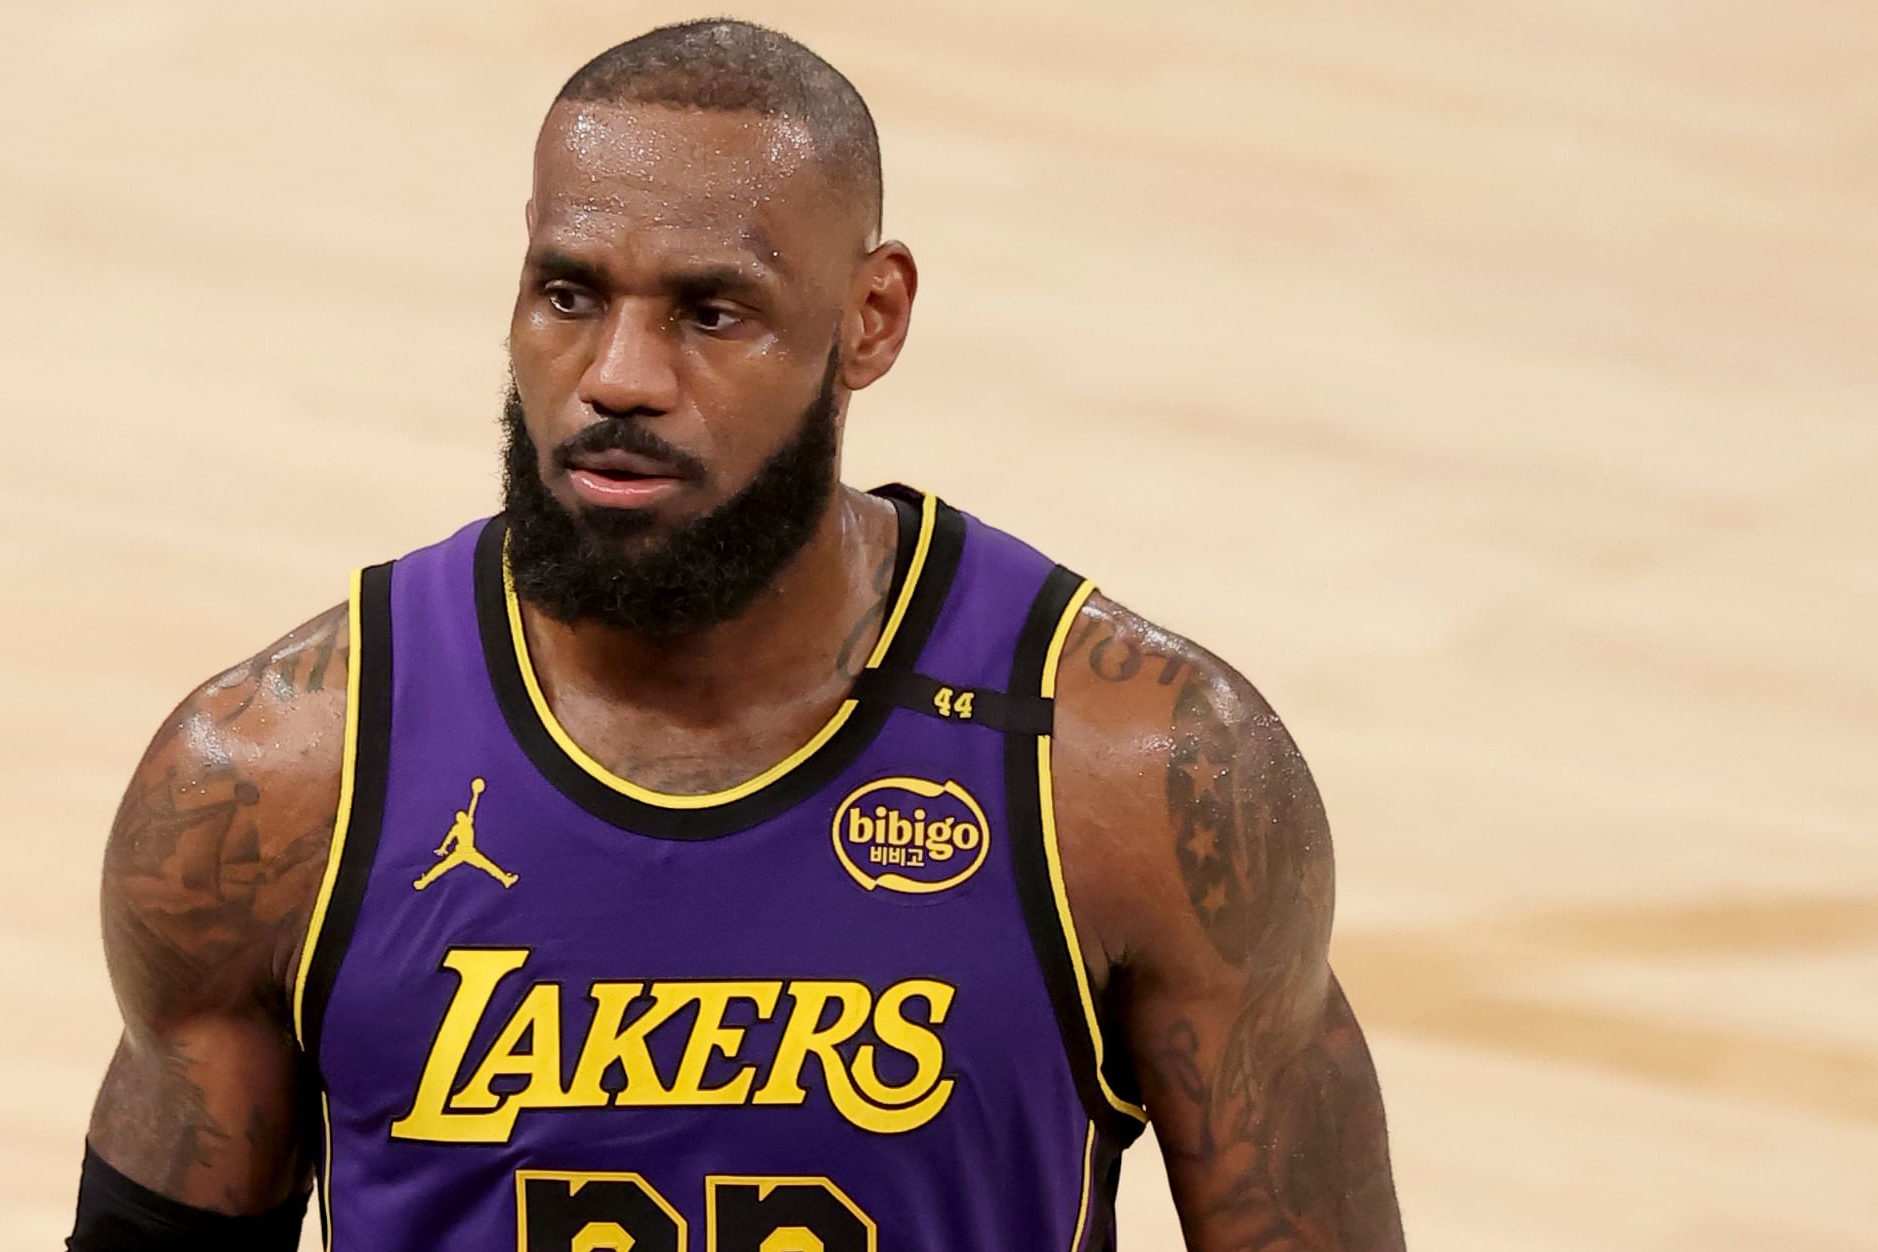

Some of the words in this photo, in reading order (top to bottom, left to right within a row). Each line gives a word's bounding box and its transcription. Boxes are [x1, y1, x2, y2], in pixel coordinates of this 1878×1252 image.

[933, 687, 974, 719] 44
[848, 805, 980, 862] bibigo
[869, 847, 925, 867] 비비고
[390, 949, 957, 1143] LAKERS
